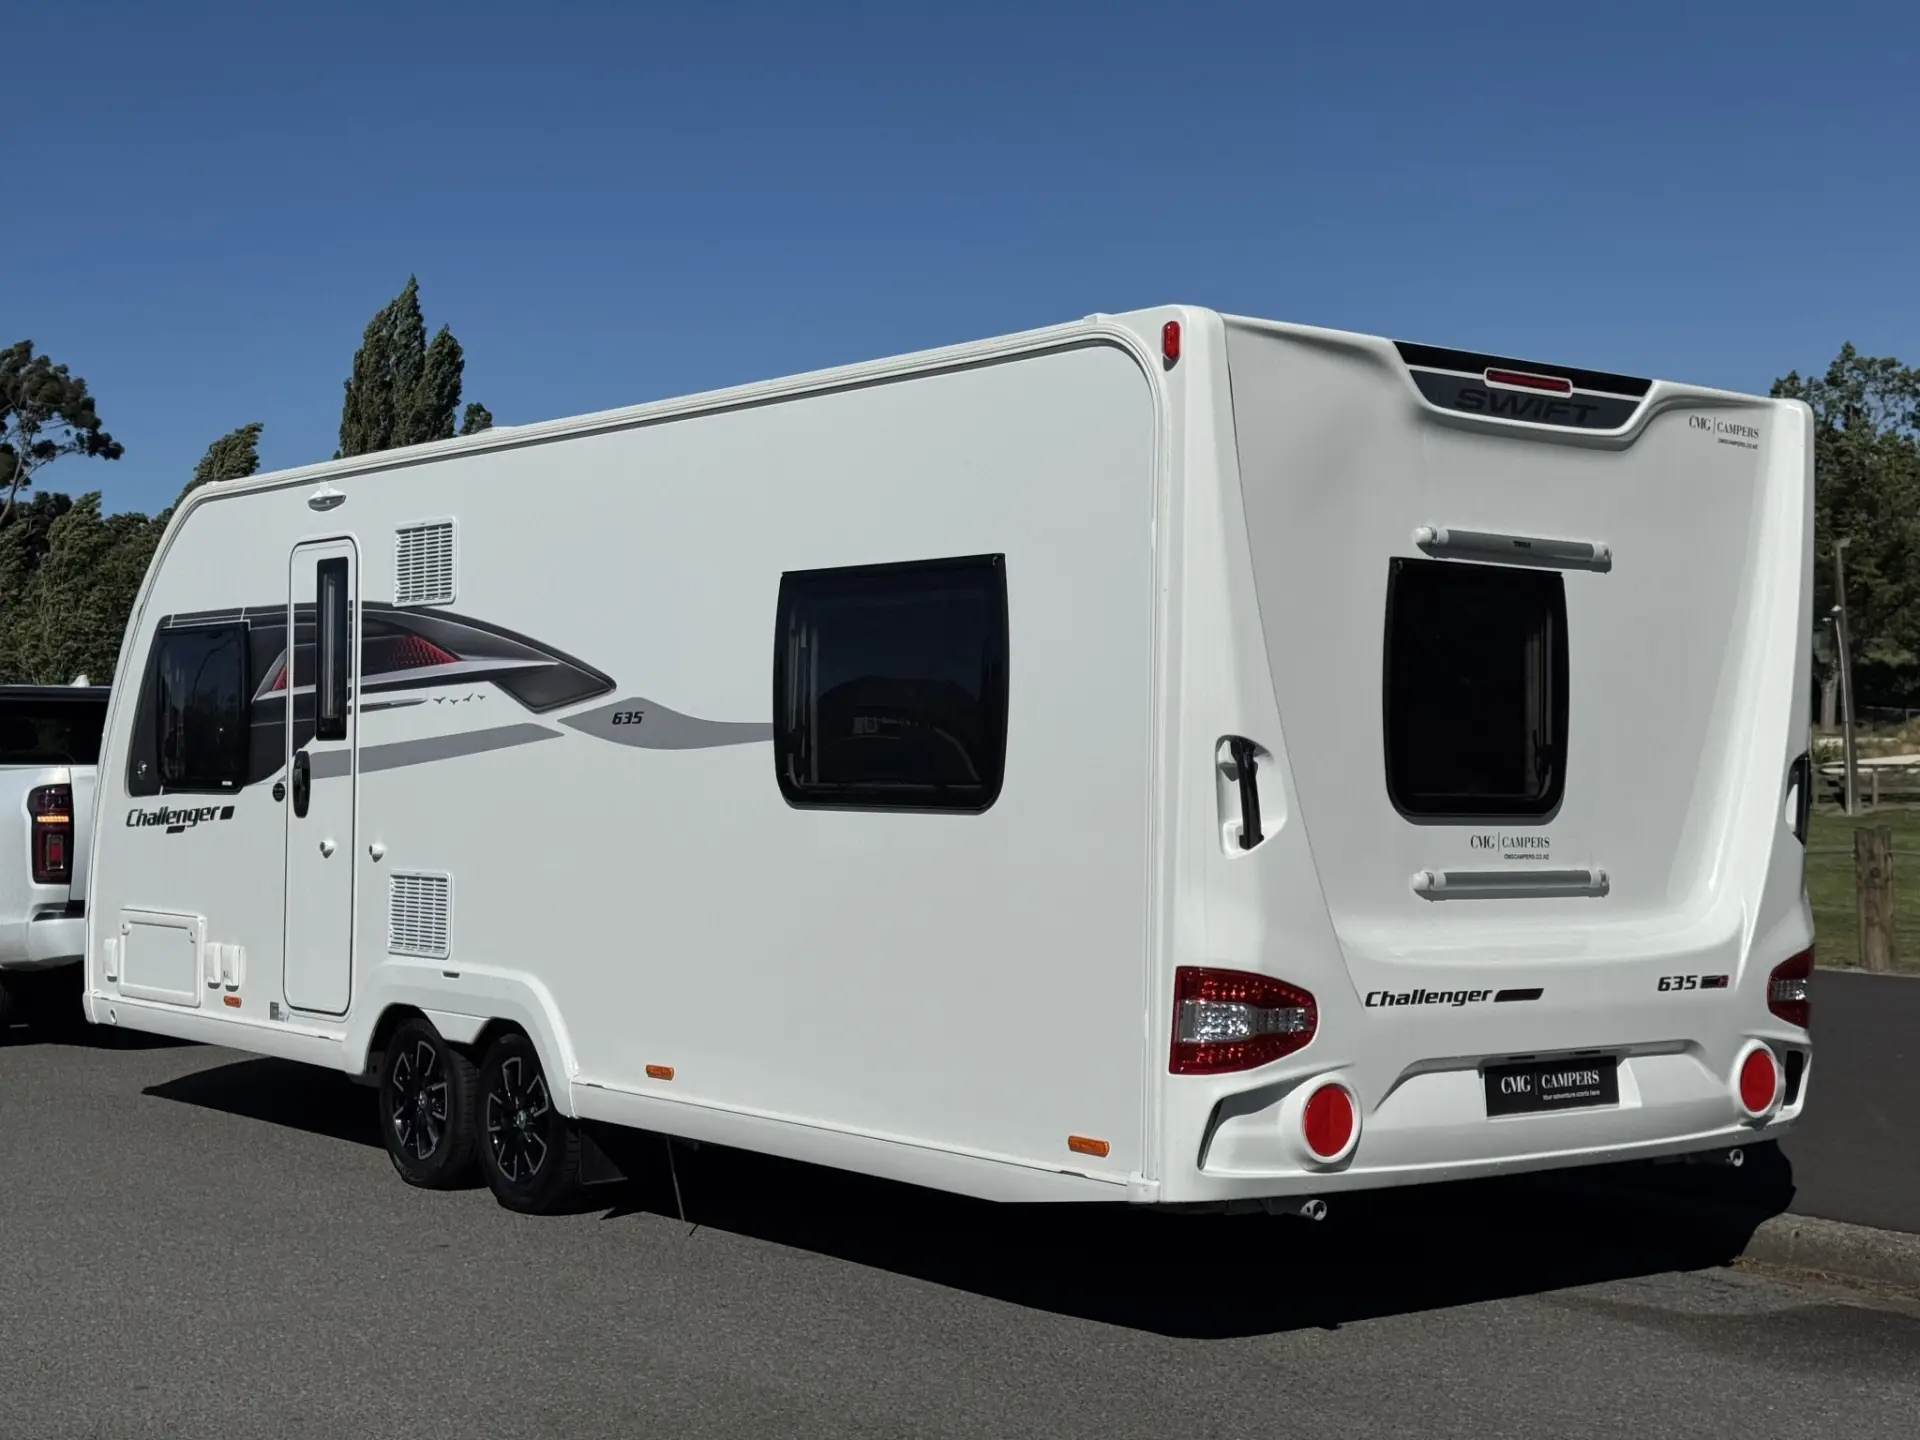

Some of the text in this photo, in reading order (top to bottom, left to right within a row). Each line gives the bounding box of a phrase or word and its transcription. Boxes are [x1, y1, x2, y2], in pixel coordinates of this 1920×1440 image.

[1454, 388, 1599, 423] SWIFT
[1689, 415, 1759, 439] CMG CAMPERS
[612, 711, 644, 725] 635
[126, 806, 221, 828] Challenger
[1470, 834, 1550, 849] CMG CAMPERS
[1657, 975, 1698, 991] 635
[1365, 989, 1493, 1007] Challenger
[1501, 1070, 1600, 1094] CMG CAMPERS
